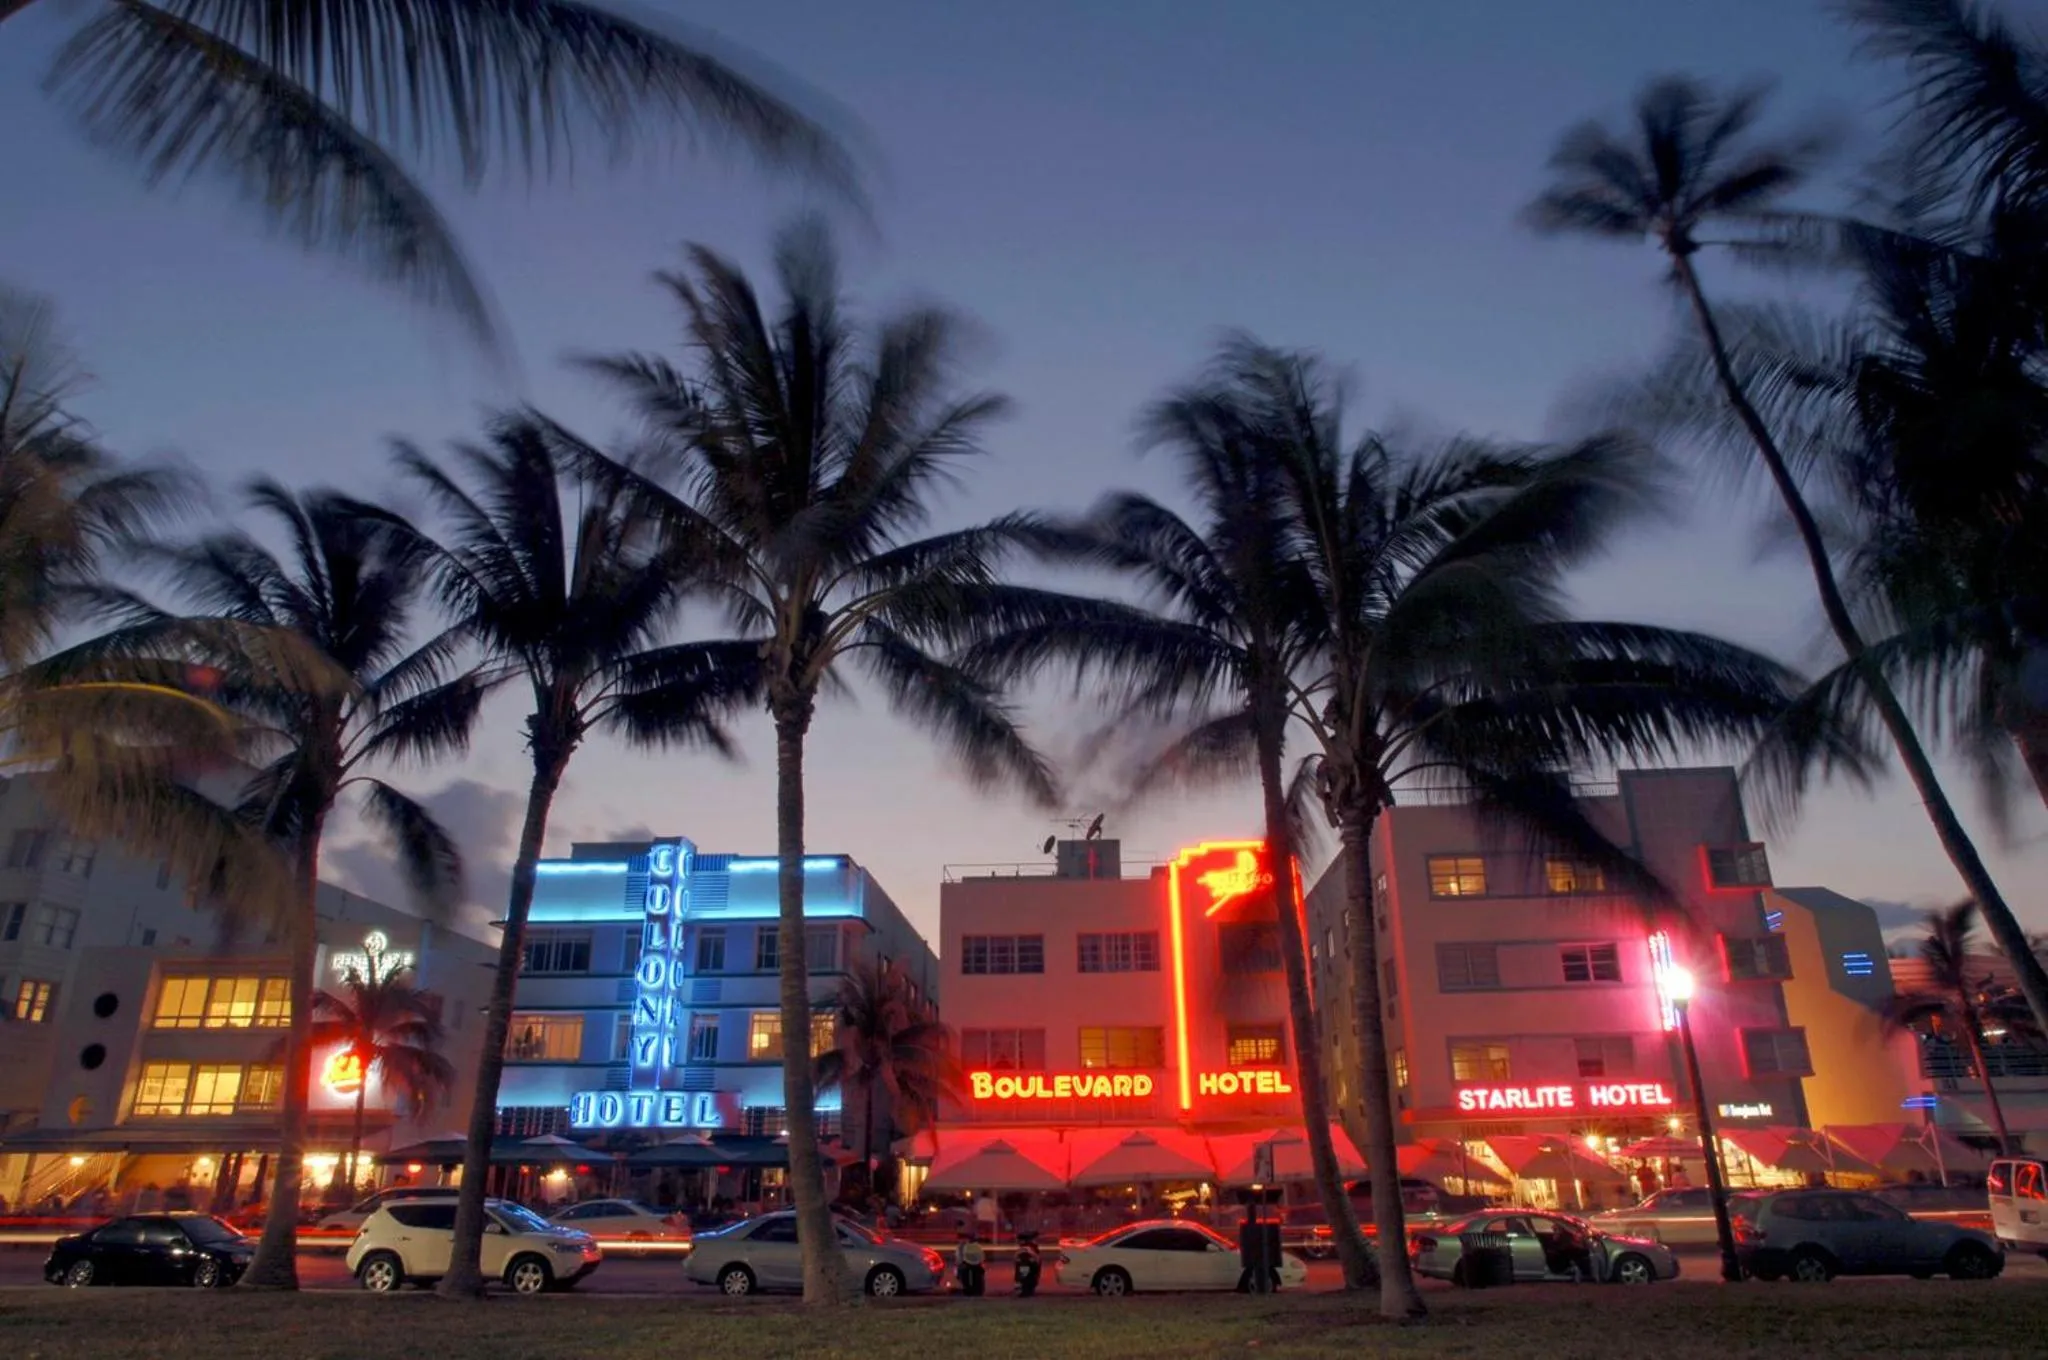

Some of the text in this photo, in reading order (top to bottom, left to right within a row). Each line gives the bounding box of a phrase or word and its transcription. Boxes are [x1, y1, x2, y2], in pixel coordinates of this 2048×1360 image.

[632, 844, 674, 1068] COLONY
[970, 1070, 1292, 1099] BOULEVARD HOTEL
[1459, 1084, 1671, 1111] STARLITE HOTEL
[571, 1090, 722, 1128] HOTEL
